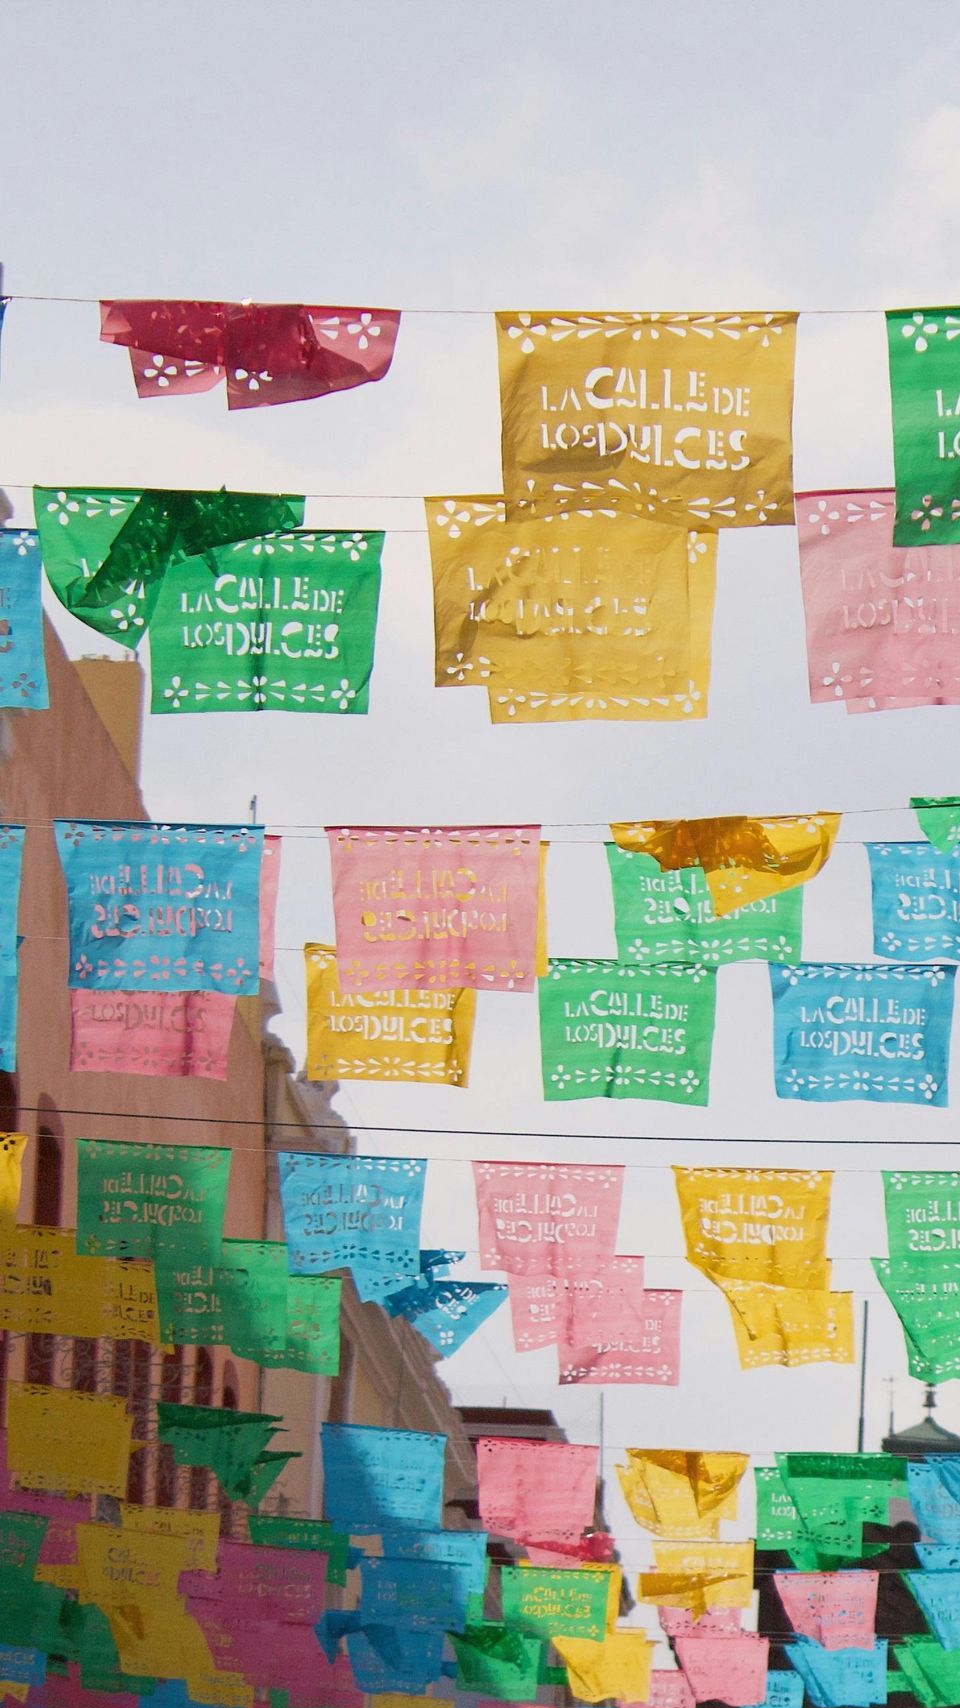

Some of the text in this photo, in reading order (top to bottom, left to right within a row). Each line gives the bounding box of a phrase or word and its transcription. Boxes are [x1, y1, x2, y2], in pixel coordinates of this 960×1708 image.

[542, 366, 750, 416] LA CALLE DE
[542, 421, 750, 471] LOS DULCES
[181, 573, 345, 614] LA CALLE DE
[183, 621, 340, 659] LOS DULCES
[564, 990, 689, 1022] LA CALLE DE
[801, 995, 926, 1026] LA CALLE DE
[330, 1014, 453, 1045] LOS DULCES
[565, 1022, 686, 1055] LOS DULCES
[800, 1030, 925, 1061] LOS DULCES
